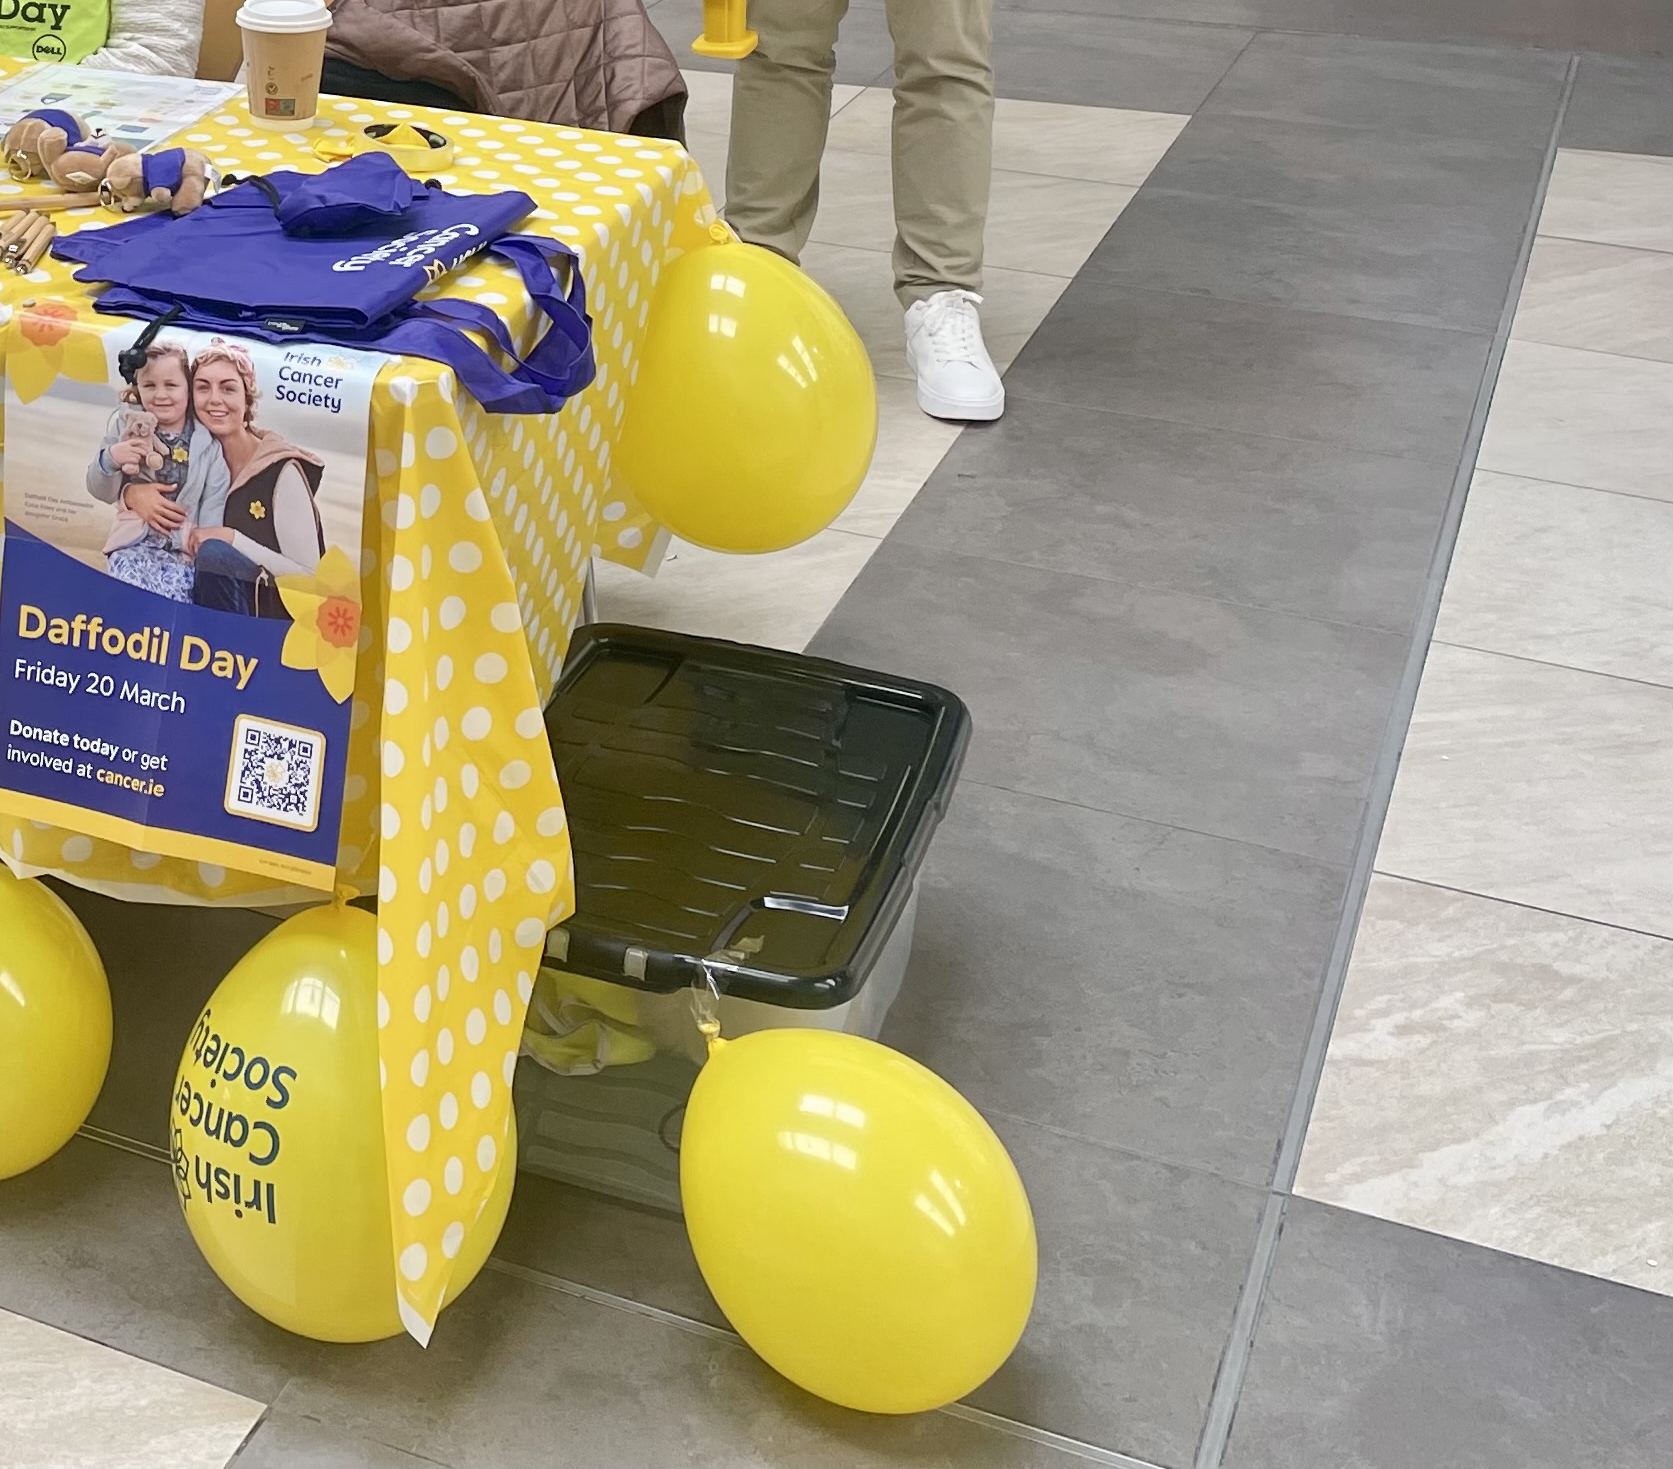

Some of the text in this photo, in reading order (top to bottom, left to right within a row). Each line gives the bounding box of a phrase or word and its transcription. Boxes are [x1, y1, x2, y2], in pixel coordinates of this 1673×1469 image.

[36, 45, 62, 55] DELL
[278, 366, 343, 390] Cancer
[283, 351, 322, 367] Irish
[275, 385, 342, 414] Society
[18, 604, 259, 691] Daffodil Day
[14, 658, 186, 714] Friday 20 March
[7, 743, 165, 798] involved at cancer.ie
[9, 719, 168, 772] Donate today or get
[190, 1008, 298, 1110] Society
[175, 1074, 280, 1166] Cancer
[194, 1154, 277, 1225] Irish
